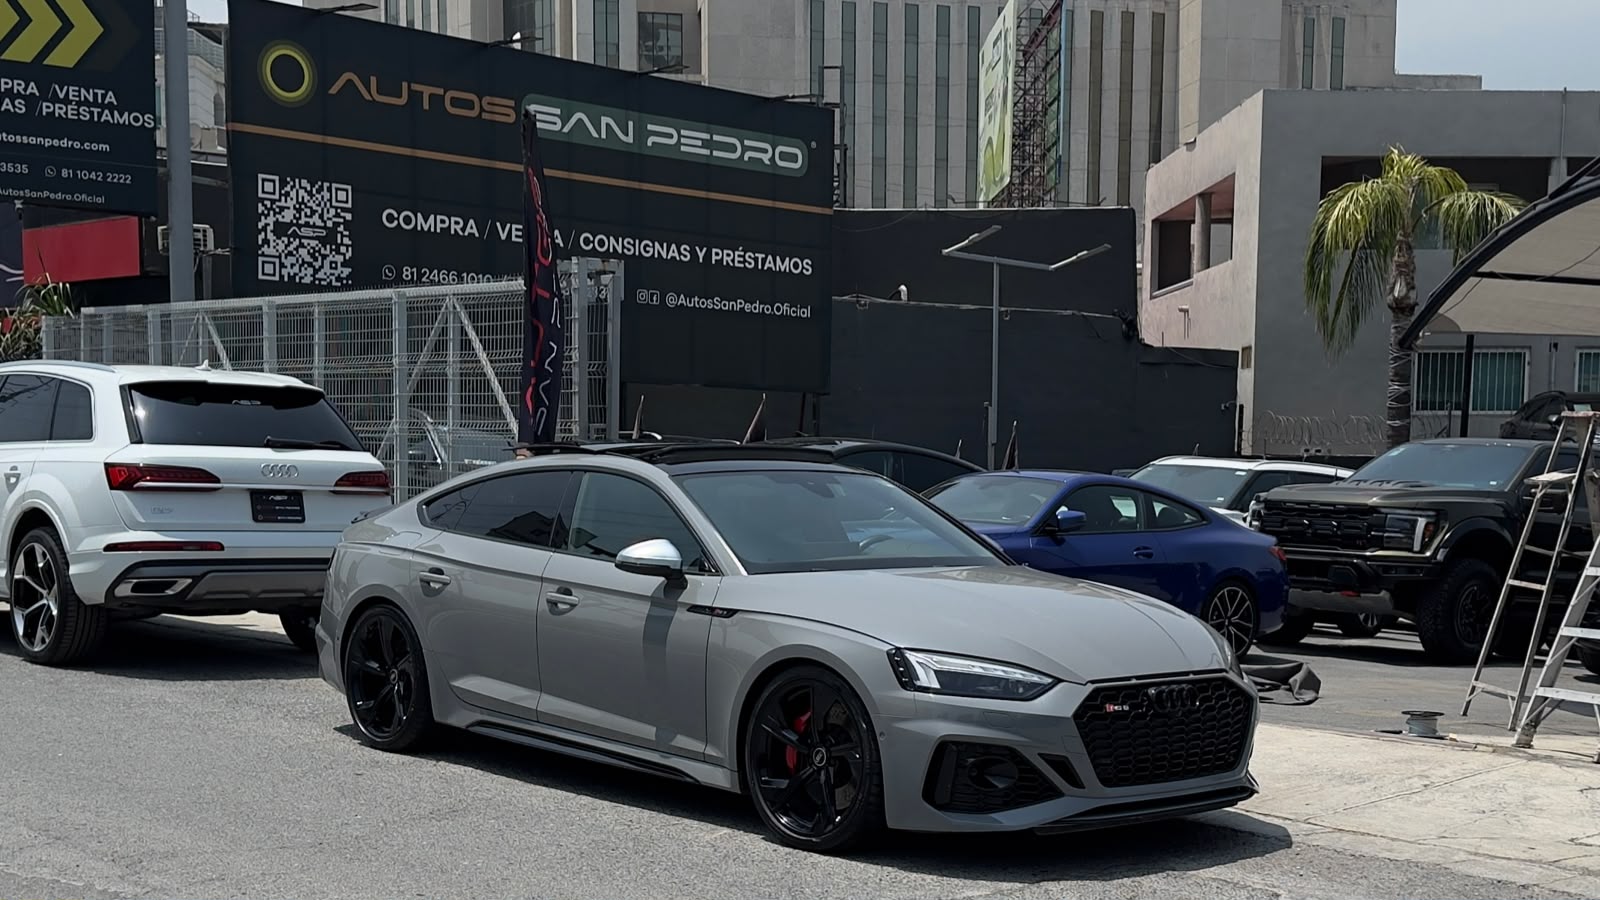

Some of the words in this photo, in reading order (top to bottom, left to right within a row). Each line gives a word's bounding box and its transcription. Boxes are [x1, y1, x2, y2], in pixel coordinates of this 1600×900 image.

[0, 78, 40, 97] PRA
[328, 72, 516, 124] AUTOS
[526, 104, 633, 143] SAN
[647, 124, 803, 169] PEDRO
[0, 131, 110, 152] tossanpedro.com
[61, 168, 73, 178] 81
[76, 170, 103, 182] 1042
[106, 173, 132, 184] 2222
[381, 208, 479, 237] COMPRA
[496, 222, 564, 248] VEA
[579, 232, 691, 262] CONSIGNAS
[695, 246, 707, 263] Y
[711, 247, 813, 275] PRÉSTAMOS
[402, 266, 417, 281] 81
[421, 268, 458, 284] 2466
[665, 292, 811, 318] @AutosSanPedro.Oficial
